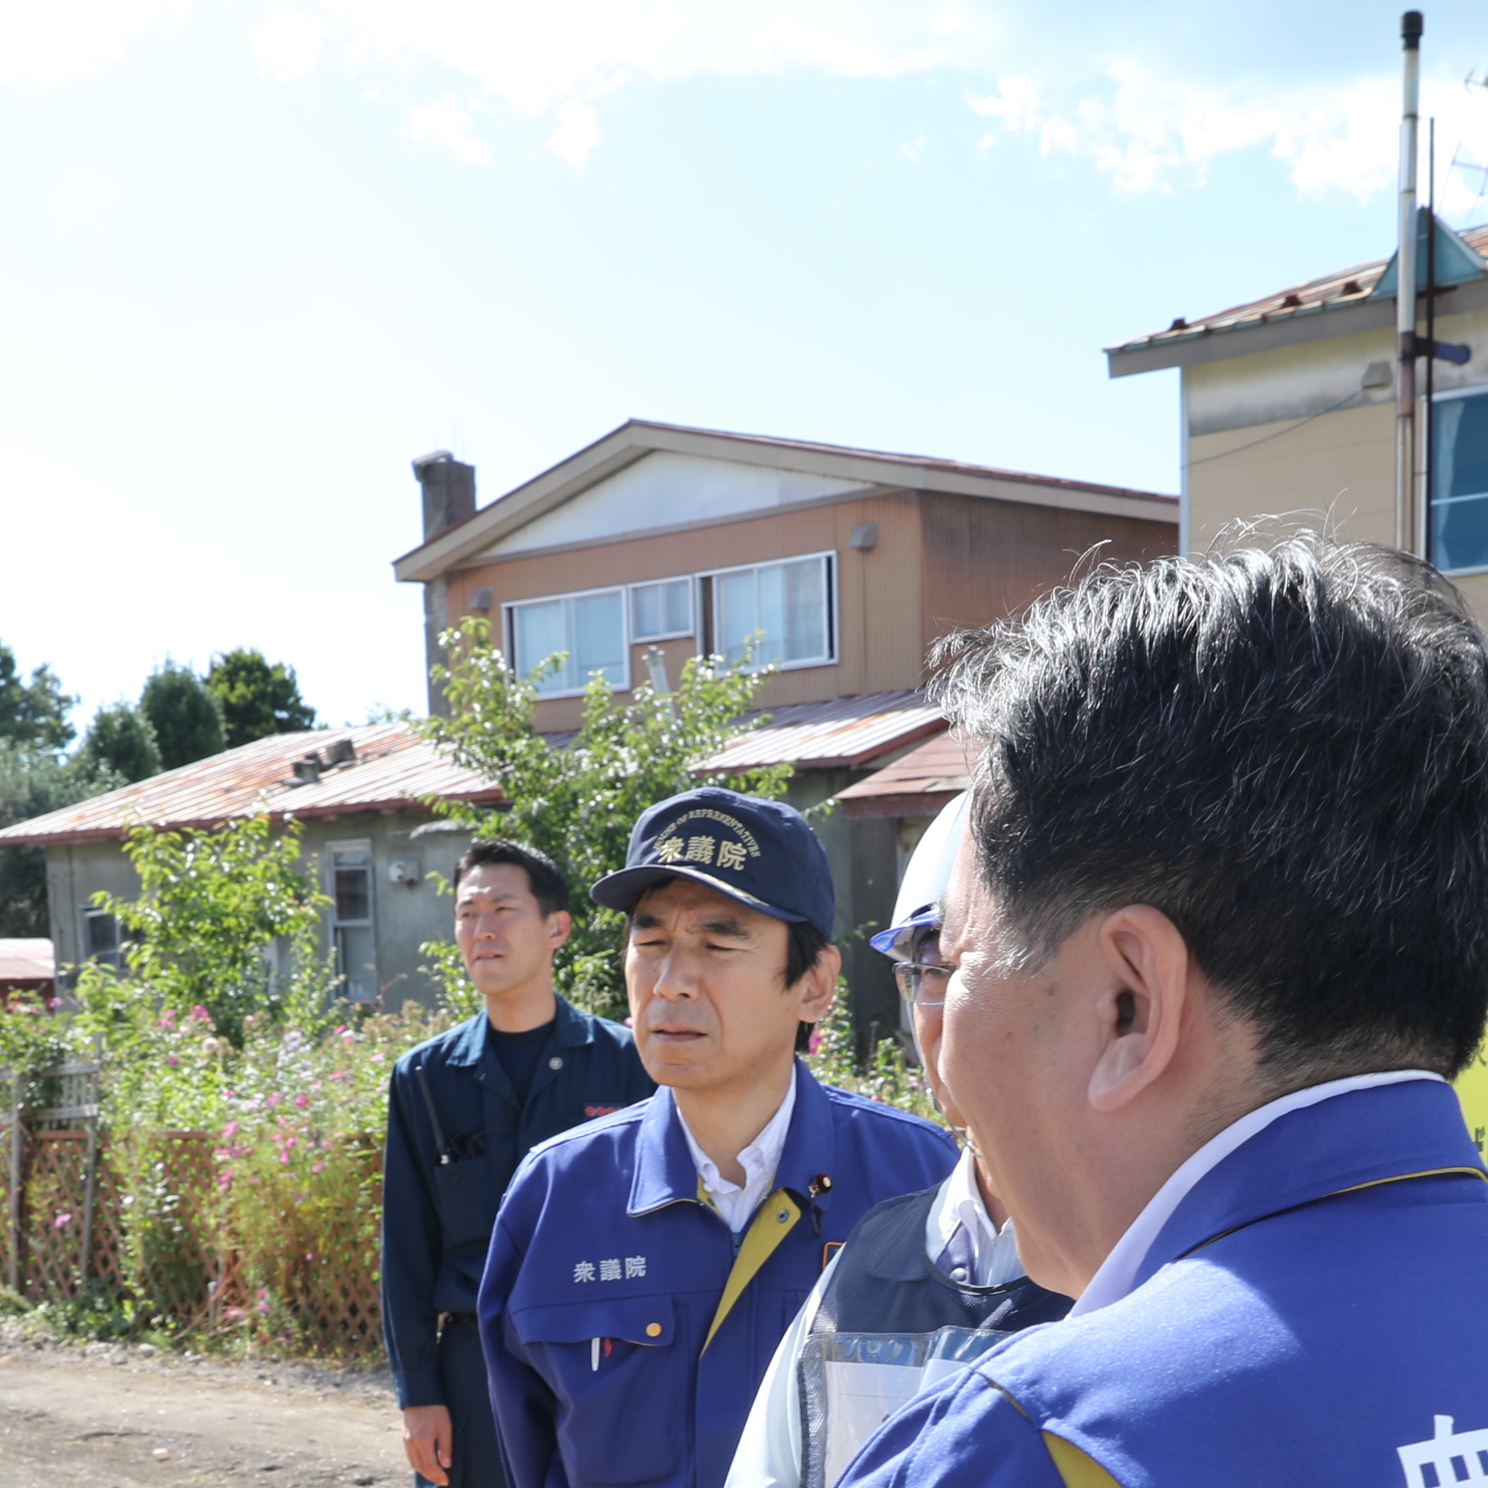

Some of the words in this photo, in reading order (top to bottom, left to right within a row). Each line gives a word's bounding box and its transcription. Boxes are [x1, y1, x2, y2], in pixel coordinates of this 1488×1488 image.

[657, 835, 747, 871] 衆議院
[573, 1256, 647, 1283] 衆議院
